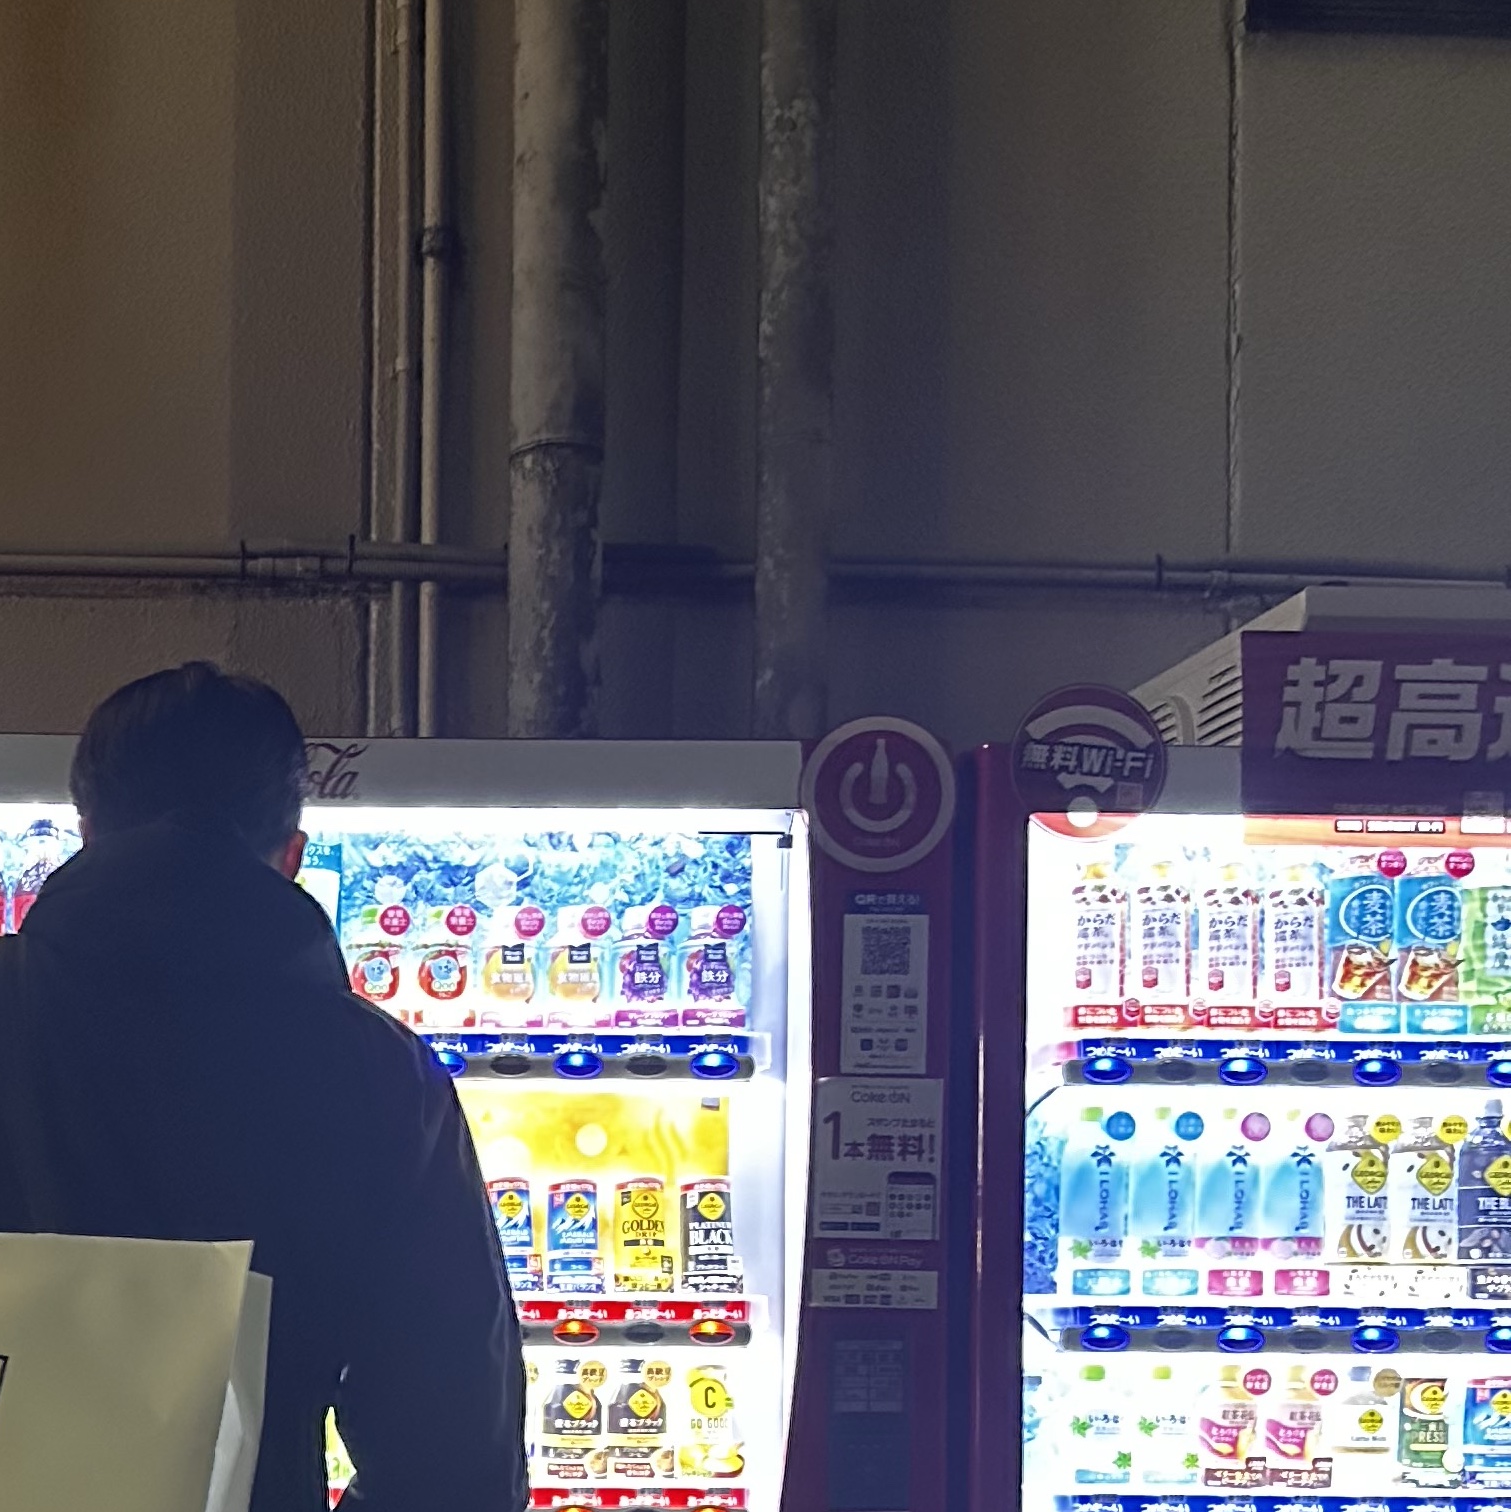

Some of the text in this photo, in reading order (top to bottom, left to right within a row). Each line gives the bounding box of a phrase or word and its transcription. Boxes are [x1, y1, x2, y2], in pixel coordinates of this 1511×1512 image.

[1275, 657, 1511, 763] 超高
[1077, 912, 1117, 925] からだ
[1141, 912, 1182, 926] からだ
[1208, 913, 1249, 927] からだ
[1362, 890, 1387, 936] 麦茶
[1430, 891, 1454, 936] 麦茶
[1274, 914, 1315, 929] からだ
[634, 971, 662, 984] 鉄分
[701, 970, 729, 984] 鉄分
[850, 1090, 886, 1104] Coke
[823, 1110, 936, 1163] 1本無料!
[1346, 1196, 1366, 1209] THE
[1411, 1197, 1431, 1210] THE
[704, 1386, 717, 1409] C
